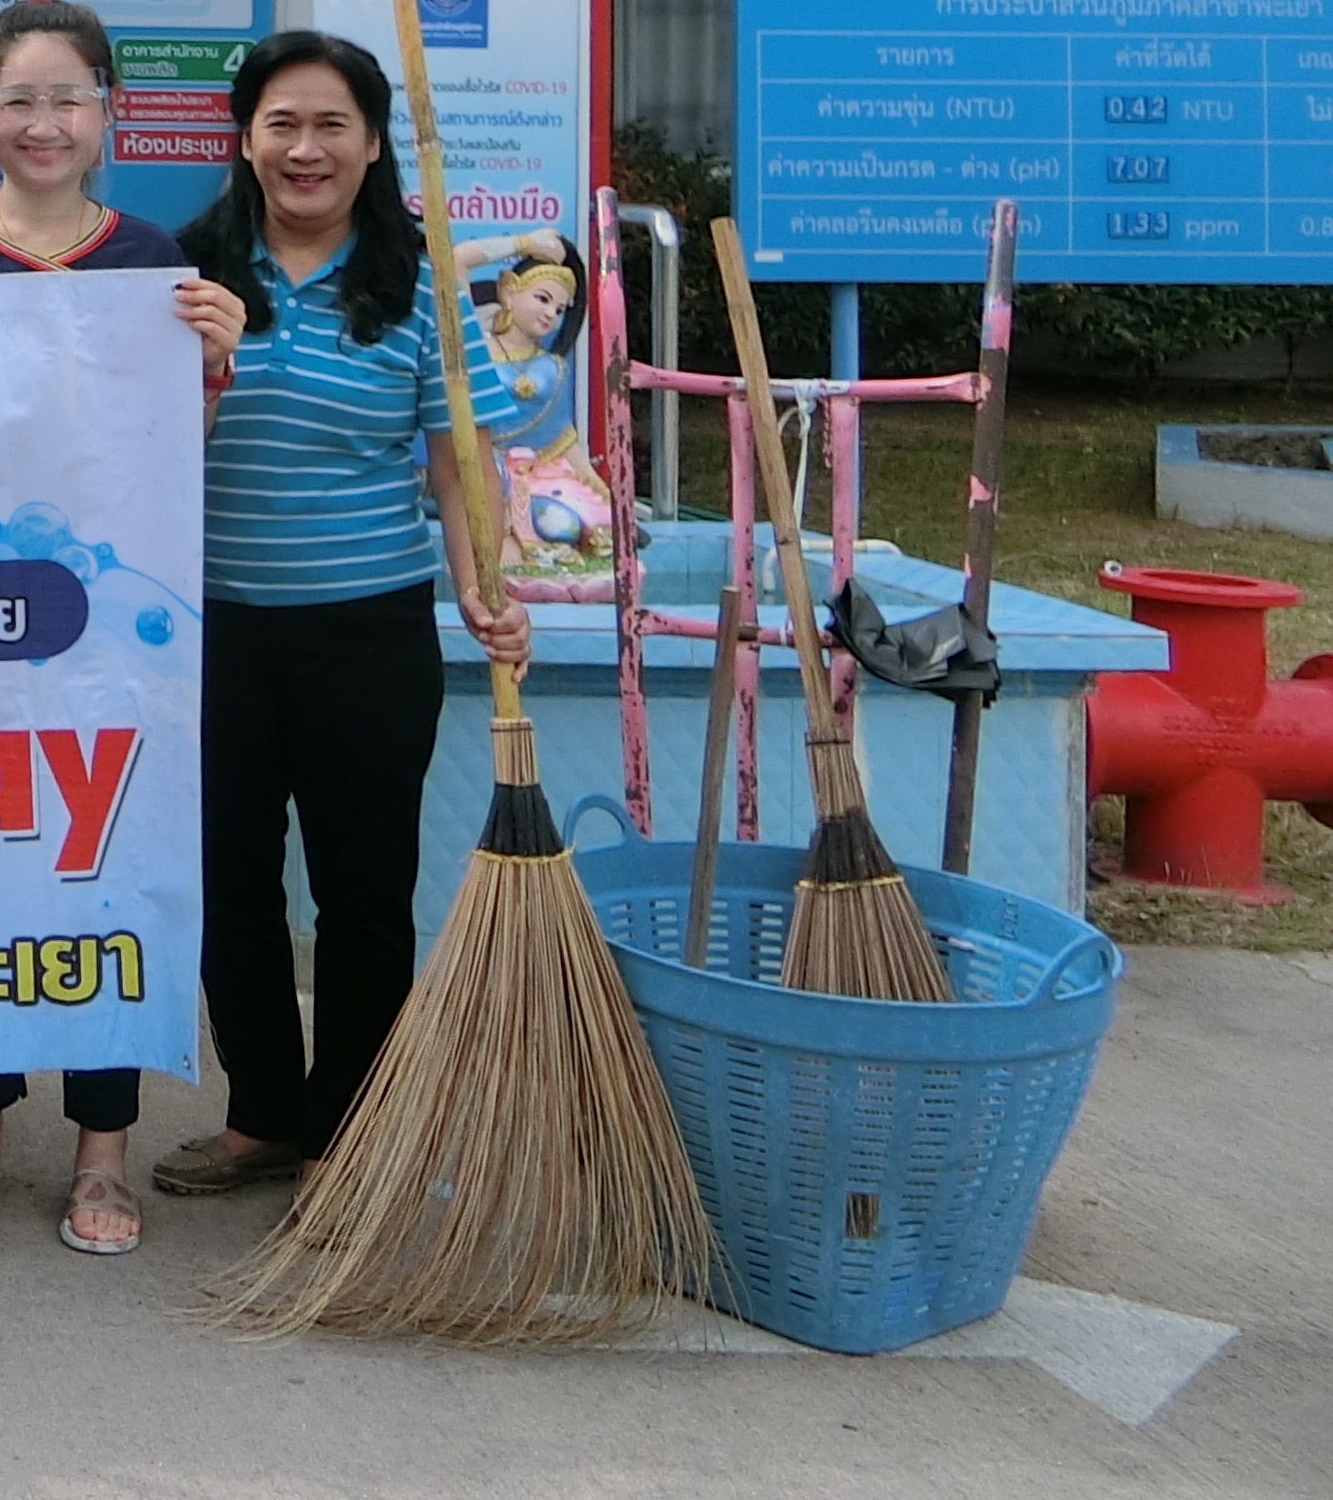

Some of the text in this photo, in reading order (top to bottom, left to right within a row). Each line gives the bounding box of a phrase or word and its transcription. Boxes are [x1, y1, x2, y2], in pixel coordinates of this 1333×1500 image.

[122, 43, 245, 73] อาคารสำนักงาน 4
[876, 47, 955, 66] รายการ
[505, 80, 567, 95] COVID-19
[818, 93, 1015, 128] ค่าความขุ่น (NTU)
[1109, 96, 1234, 121] 0.42 NTU
[122, 131, 228, 162] ห้องประชุม
[480, 158, 541, 171] COVID-19
[767, 150, 935, 179] ค่าความเป็นกรด
[961, 155, 999, 179] ด่าง
[1009, 156, 1059, 183] (pH)
[1112, 156, 1167, 181] 7.07
[790, 207, 962, 235] ค่าคลอรีนคงเหลือ
[1111, 212, 1240, 240] 1.33 ppm
